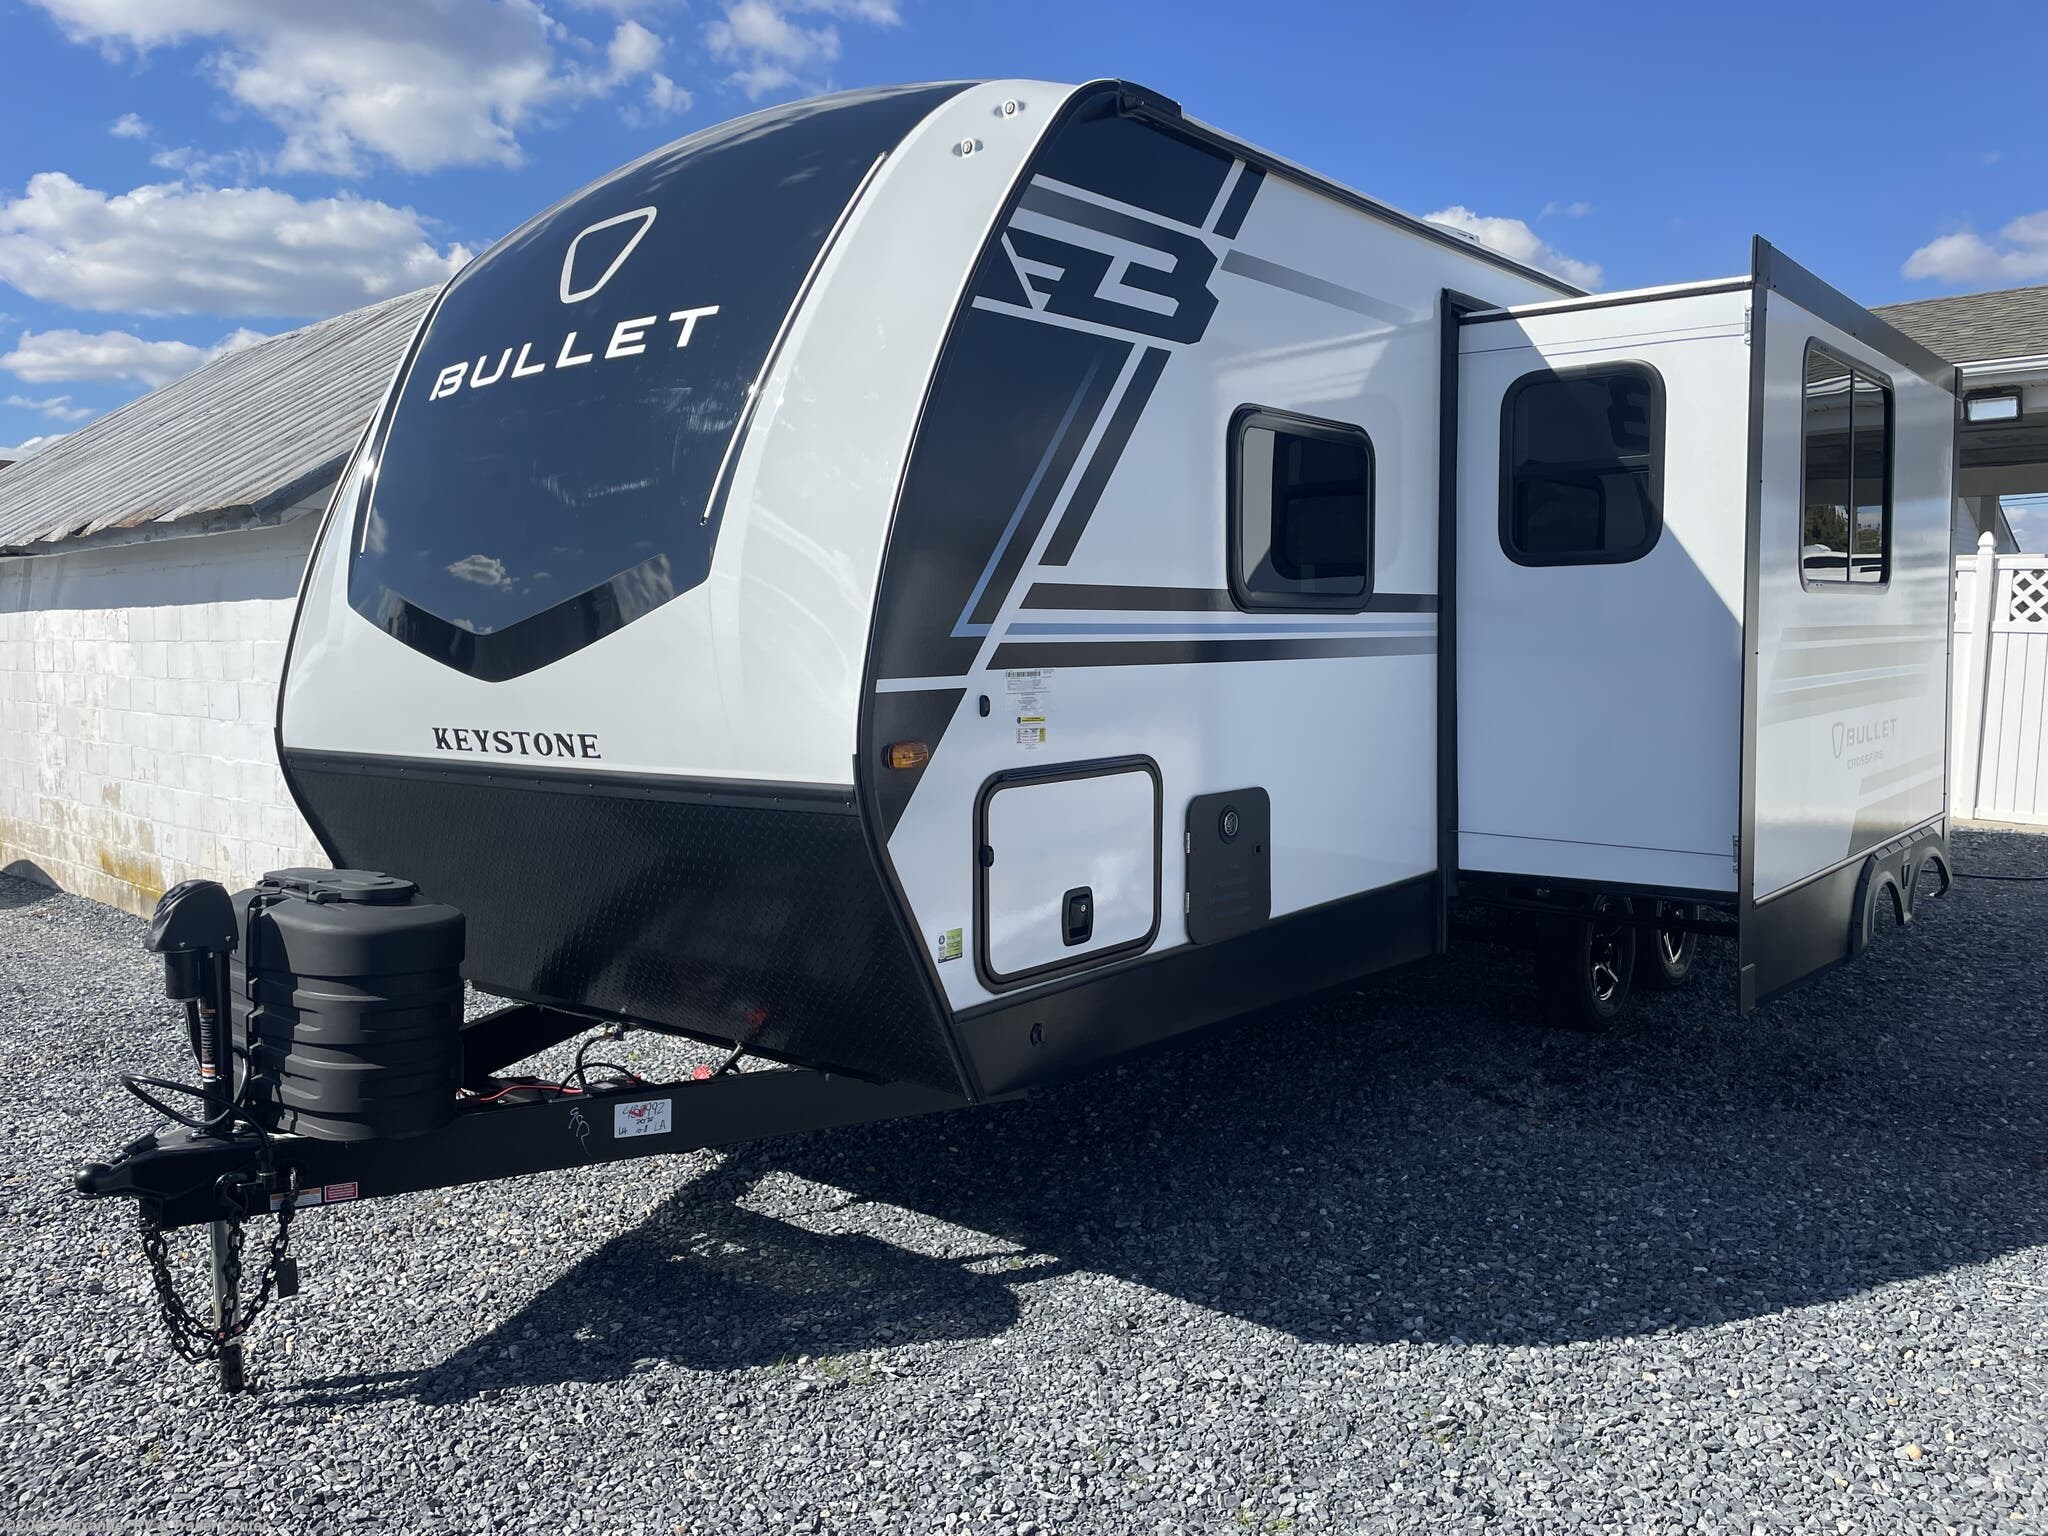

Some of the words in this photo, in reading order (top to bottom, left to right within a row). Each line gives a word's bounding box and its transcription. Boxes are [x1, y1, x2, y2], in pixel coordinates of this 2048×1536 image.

[429, 305, 720, 401] BULLET
[432, 727, 602, 759] KEYSTONE
[1847, 718, 1897, 747] BULLET
